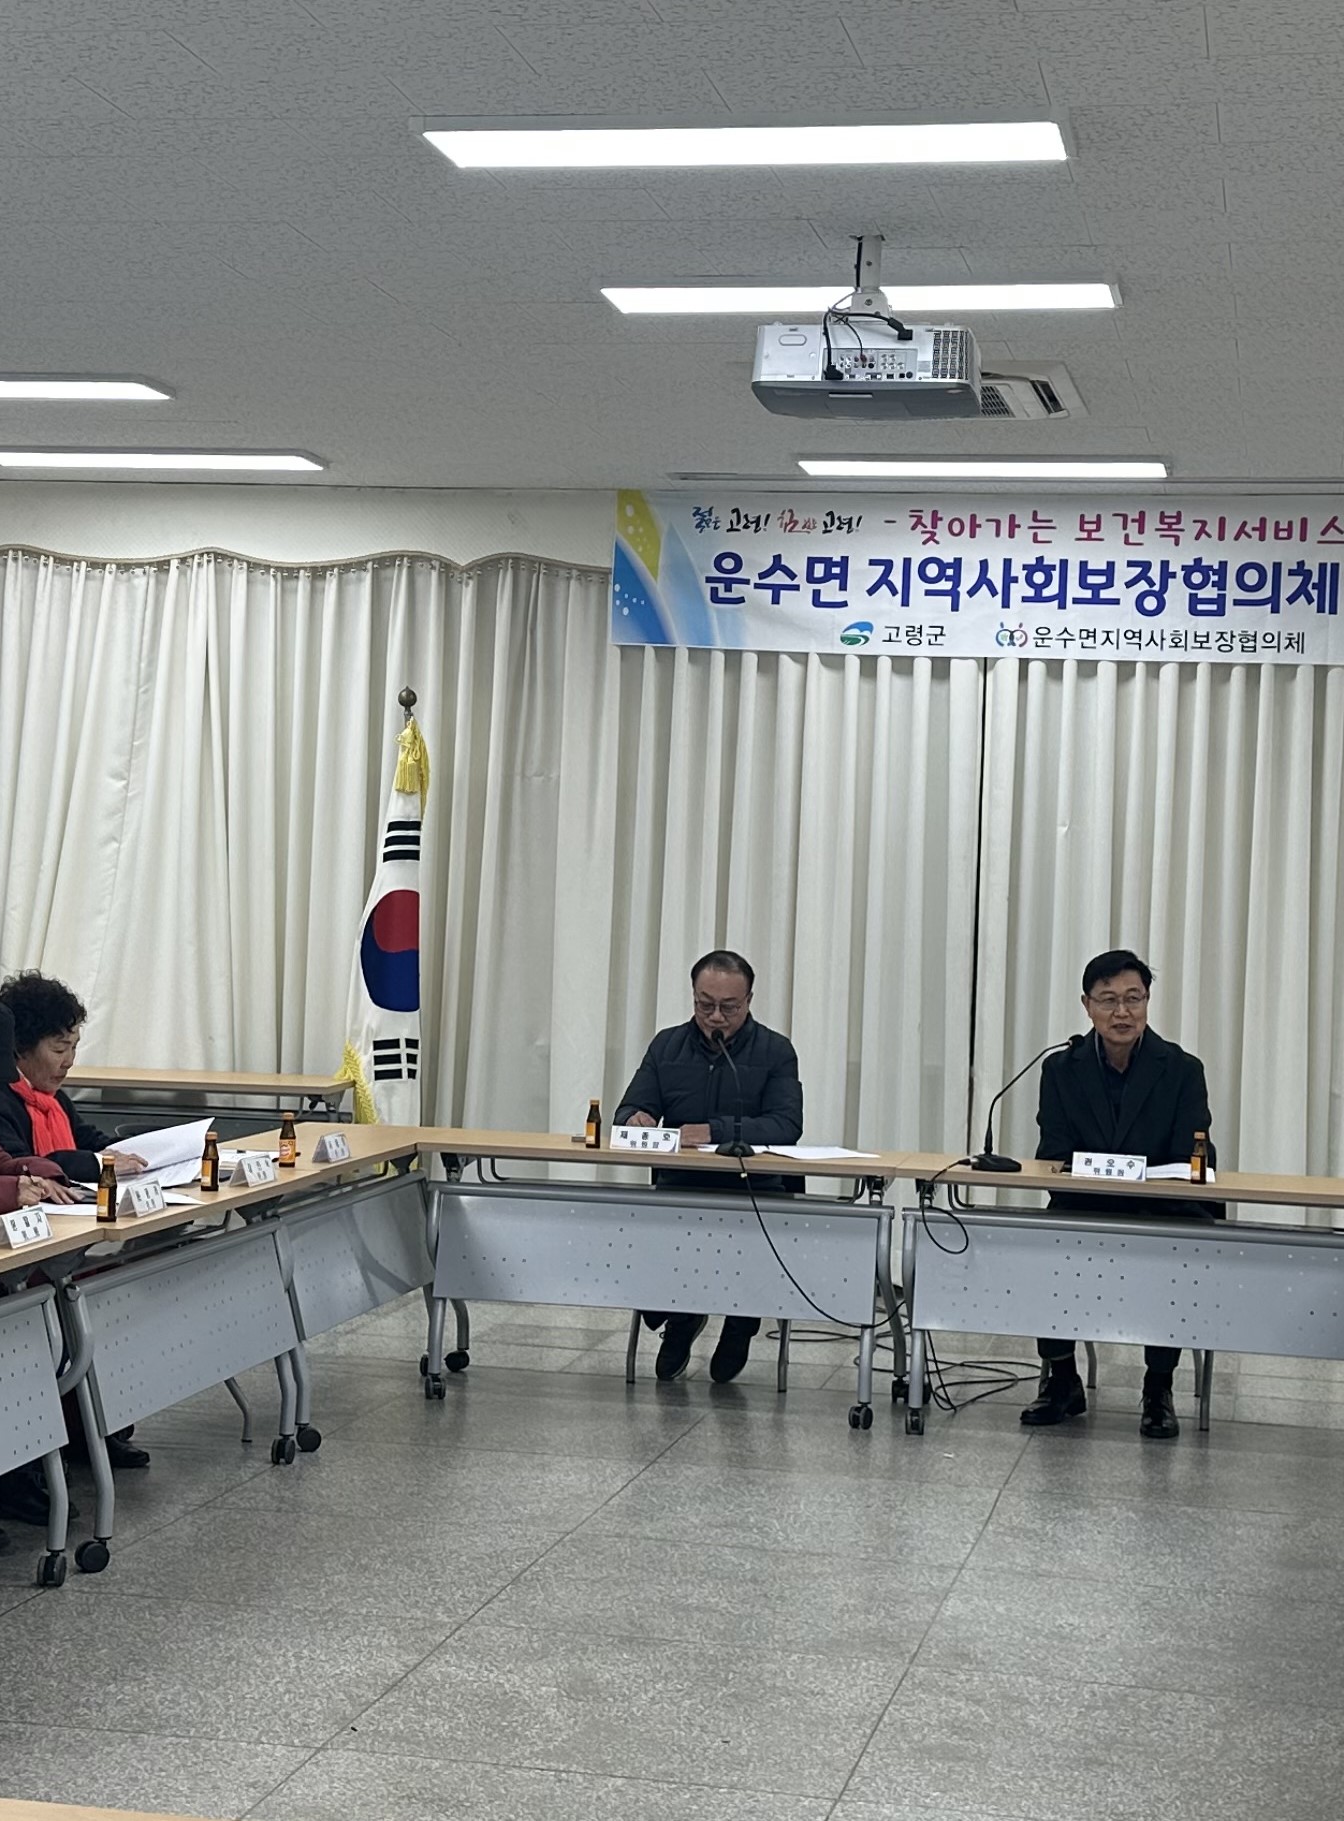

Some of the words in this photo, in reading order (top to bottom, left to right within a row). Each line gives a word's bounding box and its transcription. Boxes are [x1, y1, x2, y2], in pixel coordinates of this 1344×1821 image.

[910, 508, 1057, 546] 찾아가는
[704, 551, 850, 609] 운수면
[866, 553, 1338, 617] 지역사회보장협의체
[881, 624, 947, 648] 고령군
[1032, 625, 1306, 655] 운수면지역사회보장협의체
